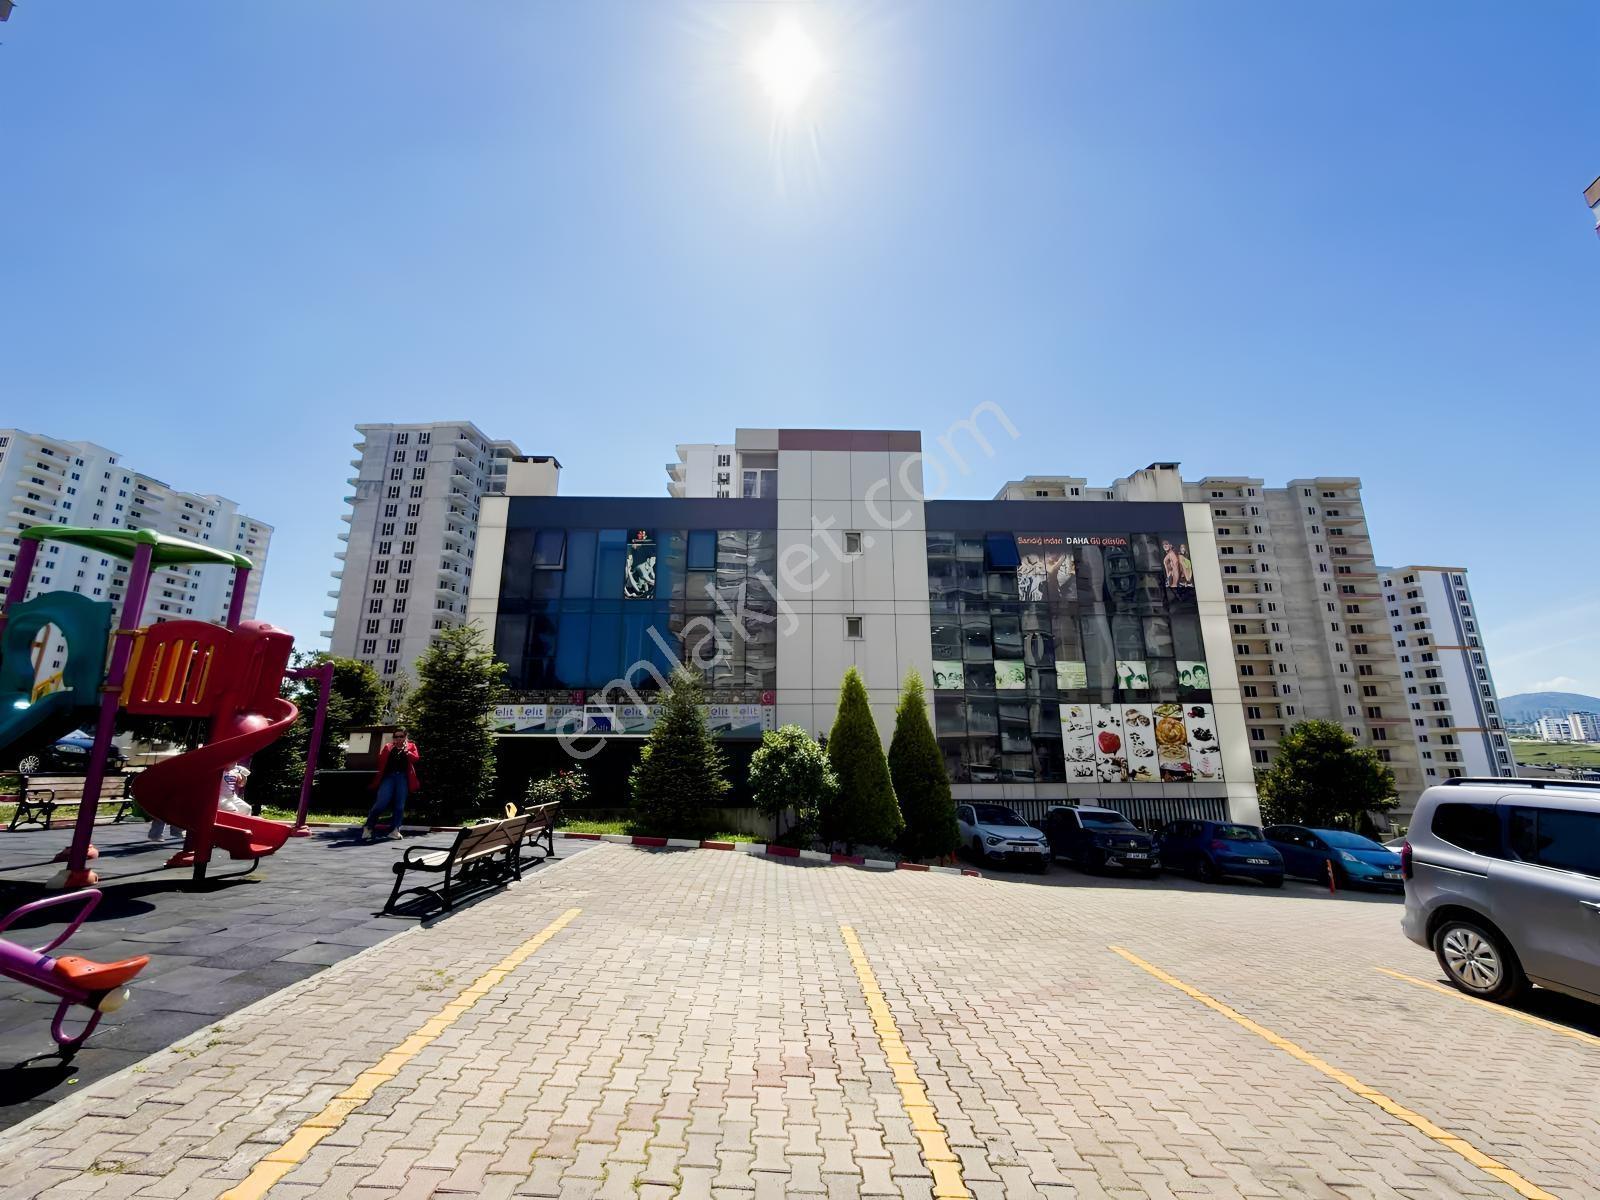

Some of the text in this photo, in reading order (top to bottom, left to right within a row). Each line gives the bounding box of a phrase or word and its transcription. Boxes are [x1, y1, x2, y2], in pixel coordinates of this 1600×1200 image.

[1066, 537, 1090, 545] DAHA
[525, 706, 543, 716] elit
[711, 707, 728, 716] elit
